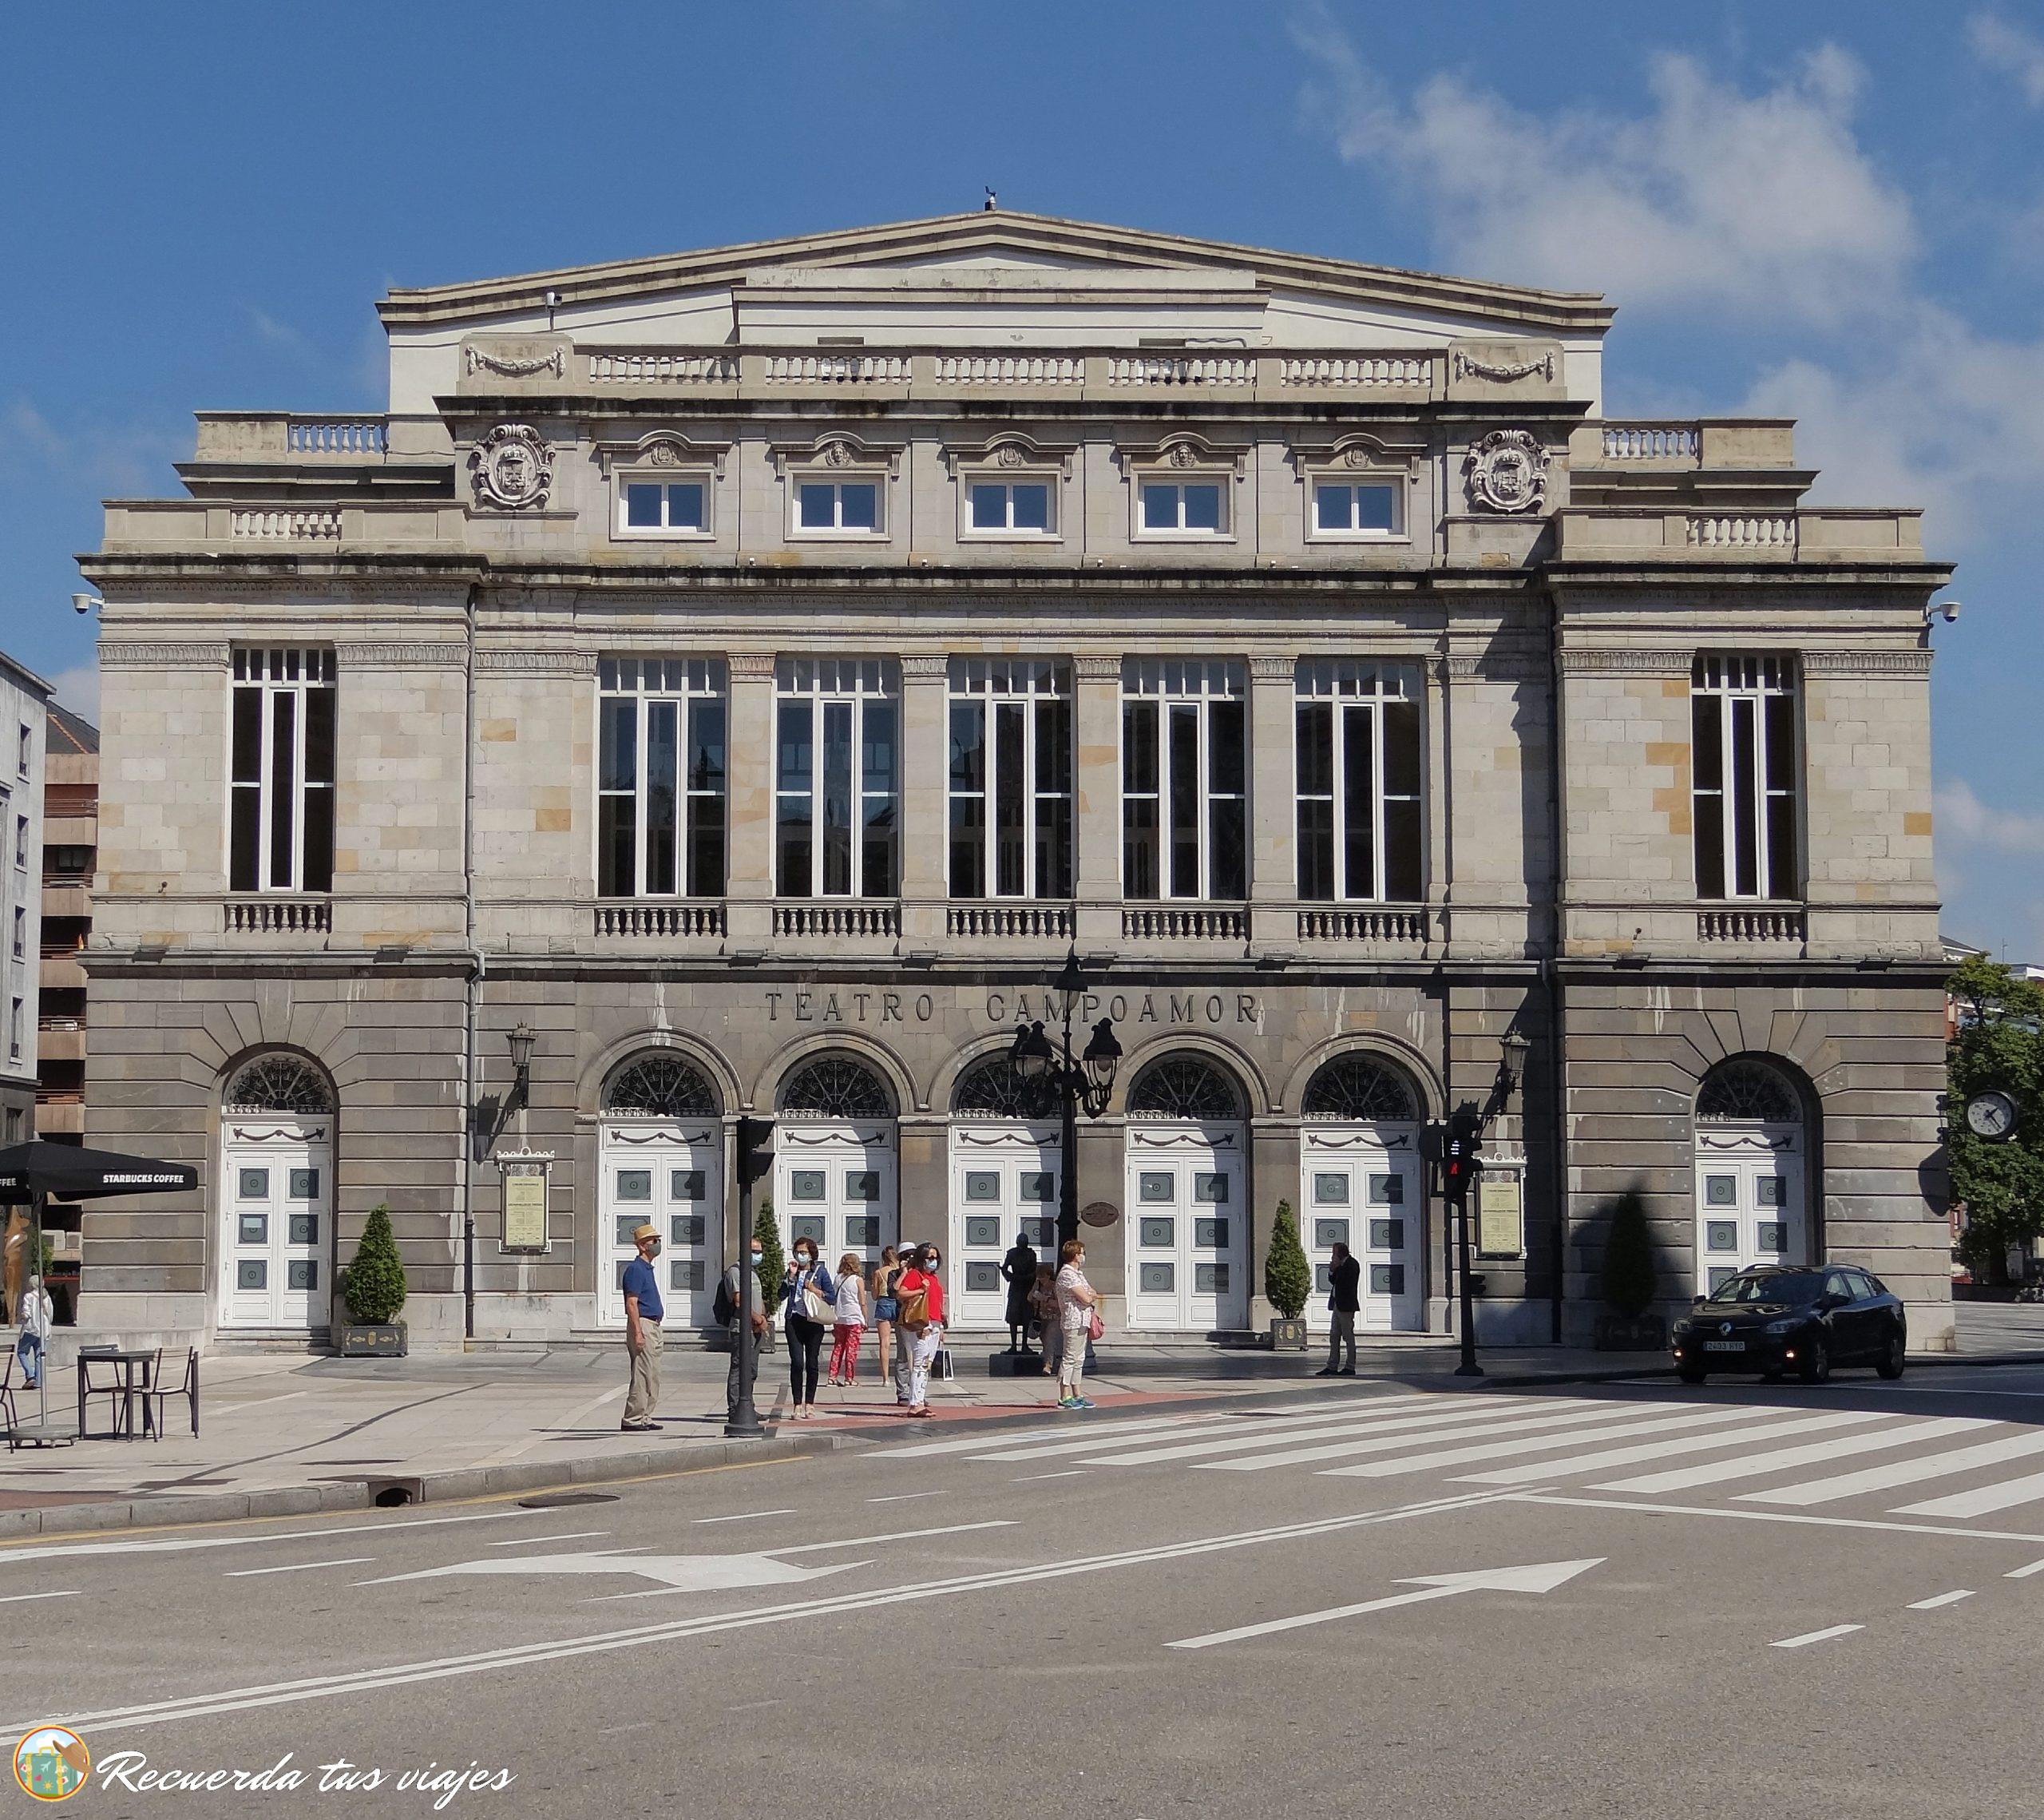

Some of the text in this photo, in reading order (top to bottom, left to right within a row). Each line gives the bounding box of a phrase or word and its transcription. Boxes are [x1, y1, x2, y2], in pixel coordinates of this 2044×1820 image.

[765, 992, 1258, 1023] TEATRO CAMPOAMOR
[103, 1174, 153, 1183] STARBUCKS
